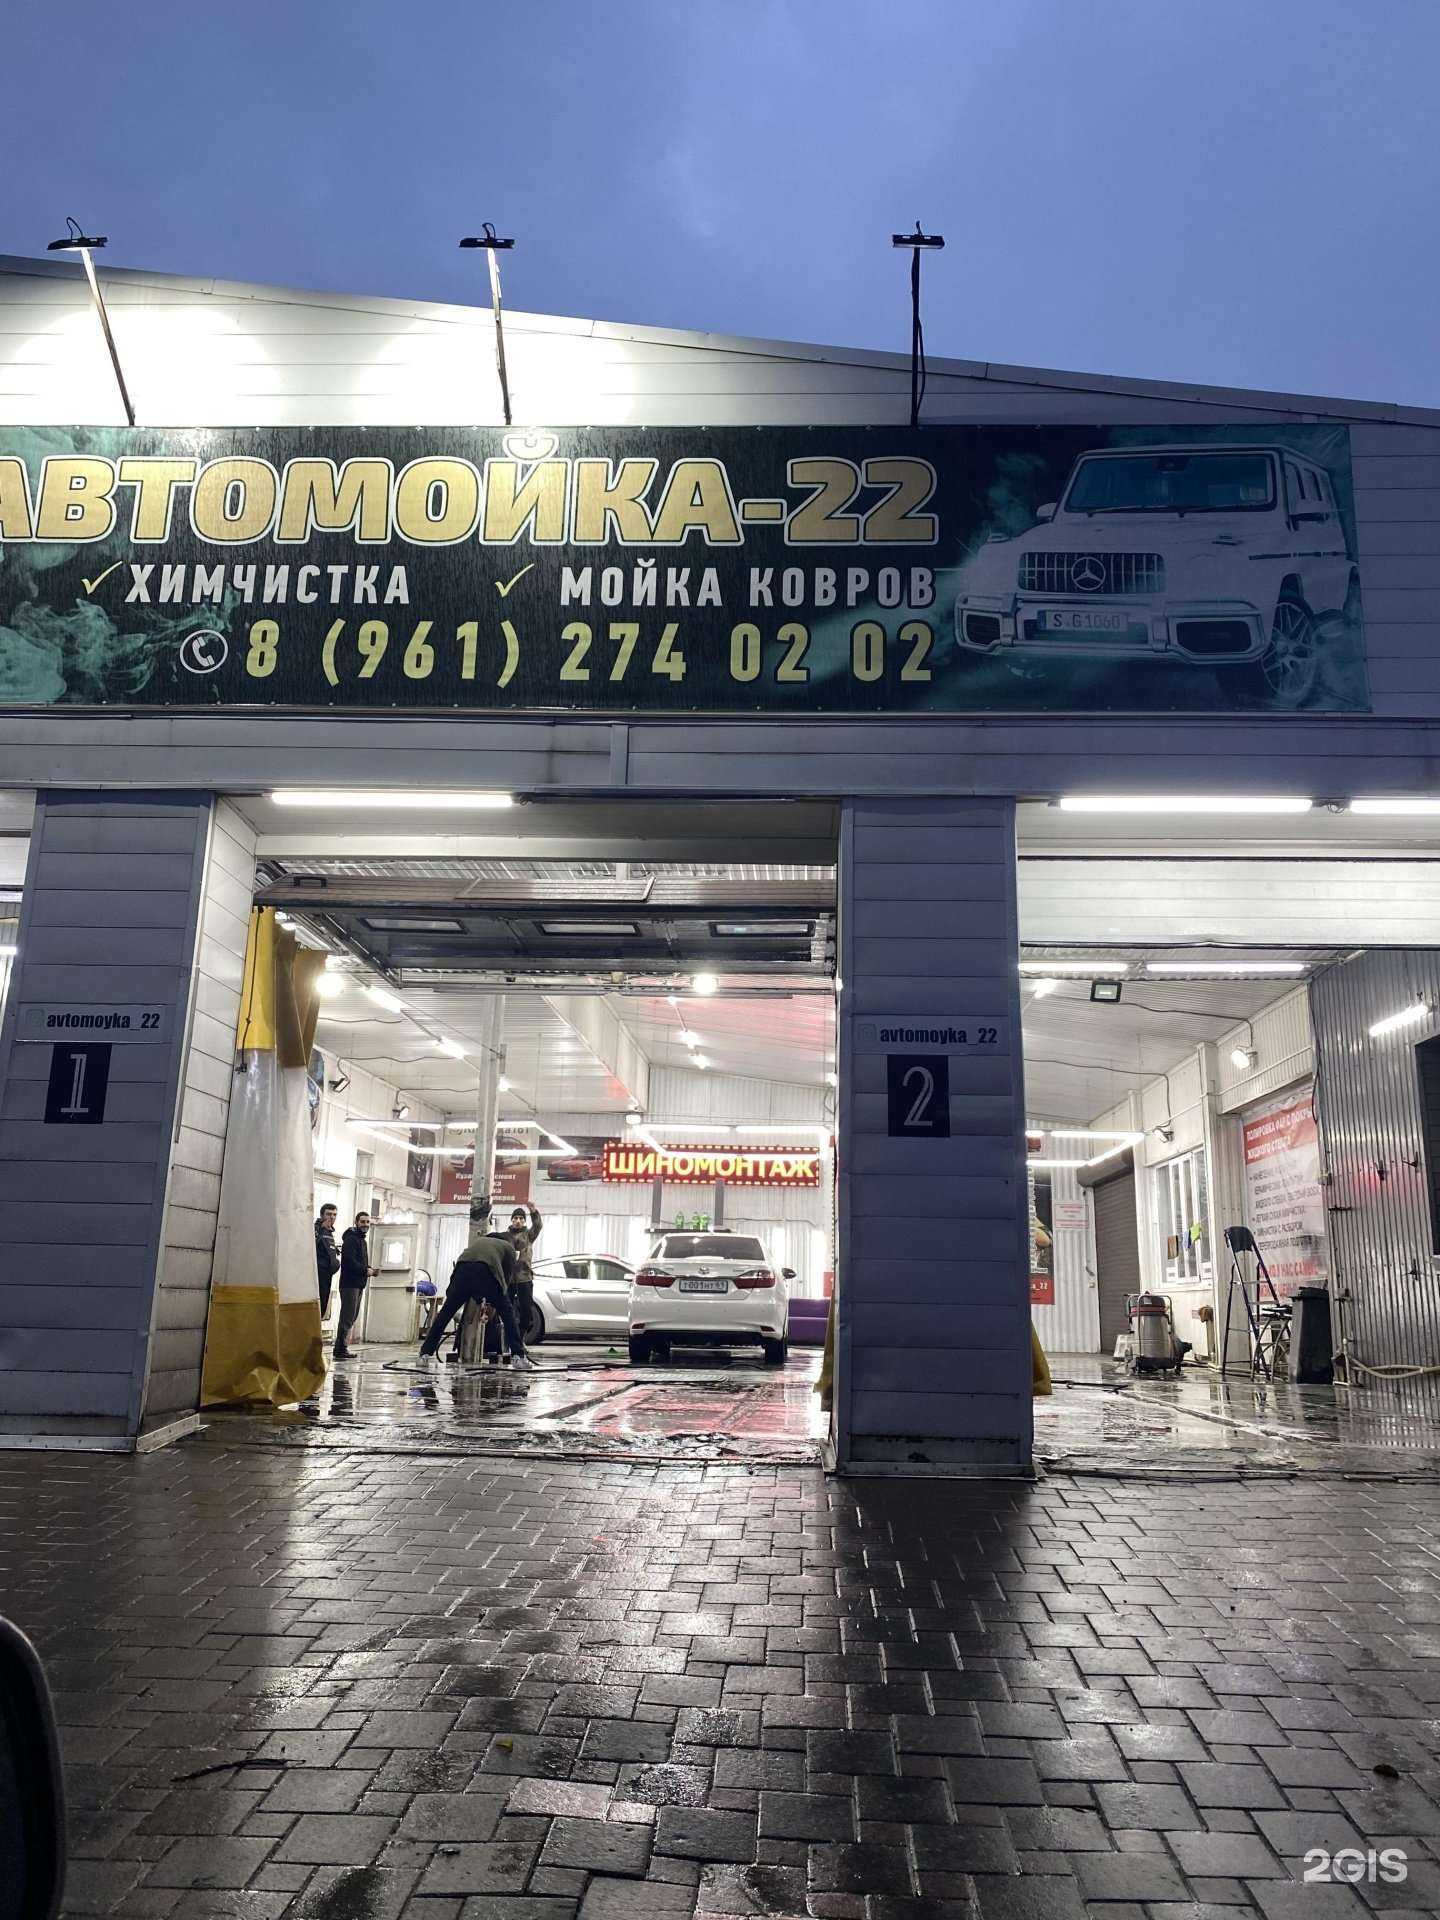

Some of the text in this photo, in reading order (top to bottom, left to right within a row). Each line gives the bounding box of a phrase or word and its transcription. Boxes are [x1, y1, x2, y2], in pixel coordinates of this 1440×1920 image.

[125, 564, 409, 605] ХИМЧИСТКА
[560, 558, 934, 607] МОЙКА КОВРОВ
[246, 617, 933, 687] 8 (961) 274 02 02
[47, 1012, 161, 1031] avtomoyka_22
[880, 1027, 999, 1046] avtomoyka_22
[61, 1053, 89, 1113] 1
[902, 1066, 934, 1127] 2
[608, 1151, 814, 1178] ШИНОМОНТАЖ
